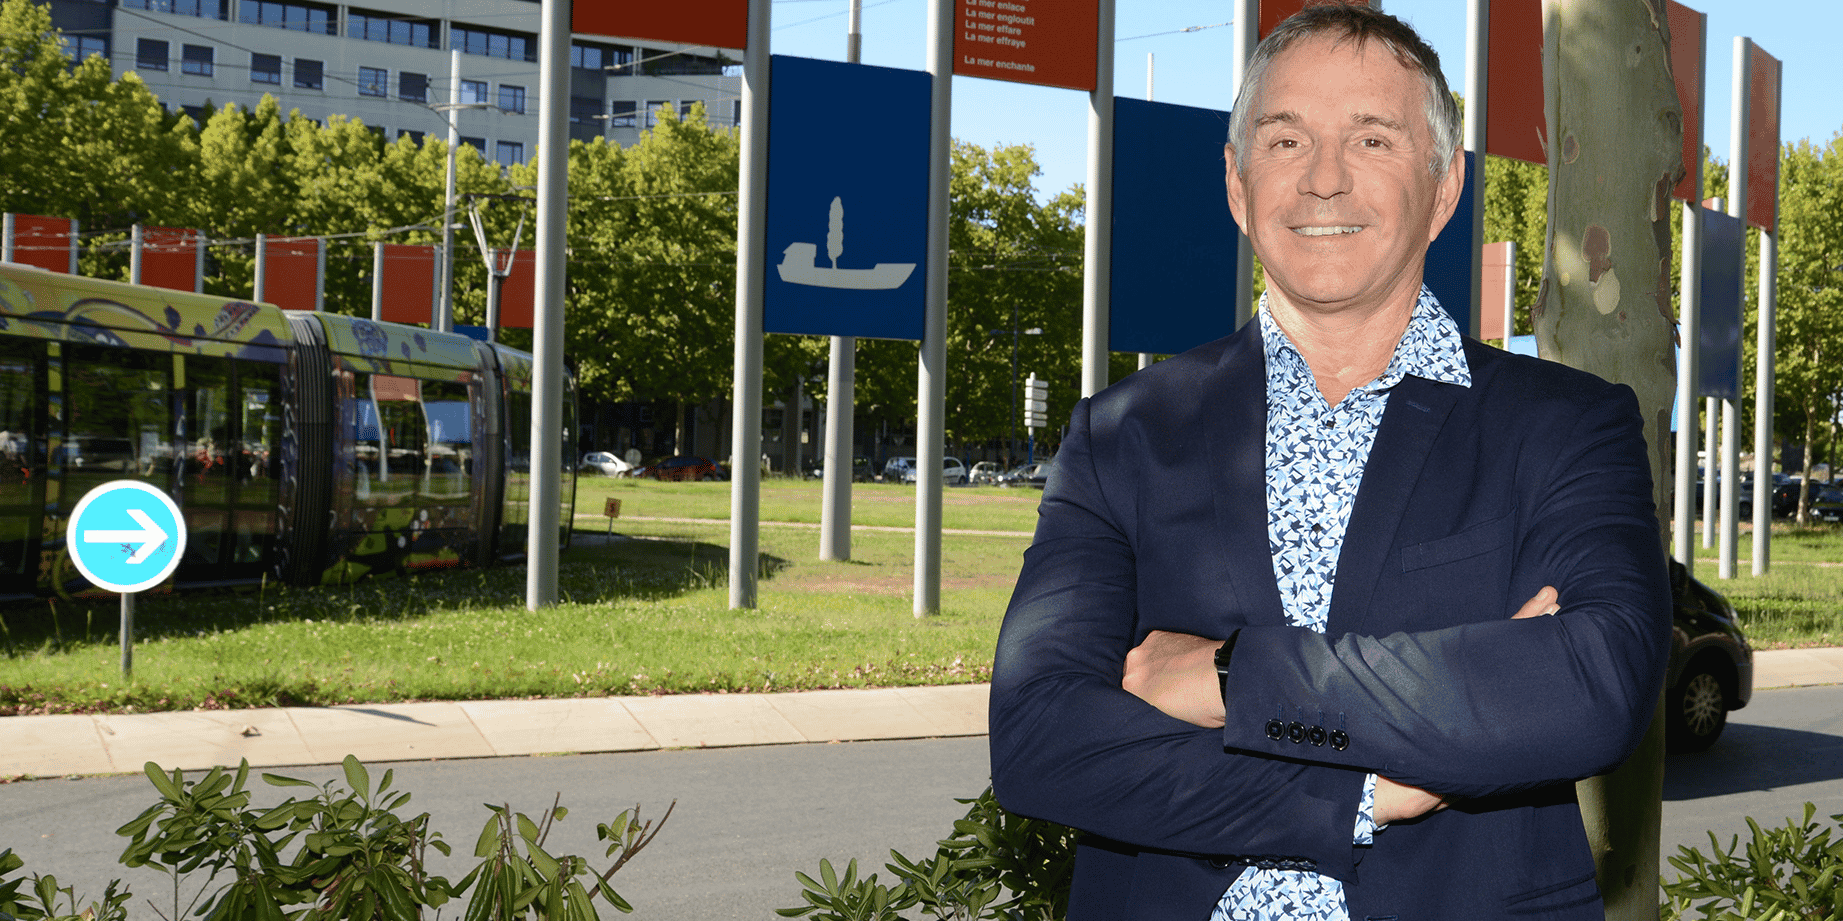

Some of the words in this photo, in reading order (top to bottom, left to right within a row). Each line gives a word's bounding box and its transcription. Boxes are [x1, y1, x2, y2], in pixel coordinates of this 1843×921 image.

[978, 0, 996, 8] mer
[997, 1, 1026, 12] enlace
[965, 8, 976, 17] La
[978, 11, 995, 19] mer
[997, 13, 1035, 26] engloutit
[965, 19, 976, 29] La
[978, 23, 995, 32] mer
[996, 25, 1022, 36] effare
[964, 31, 976, 41] La
[978, 35, 995, 43] mer
[996, 37, 1026, 49] effraye
[964, 55, 976, 65] La
[977, 58, 994, 67] mer
[996, 60, 1035, 72] enchante
